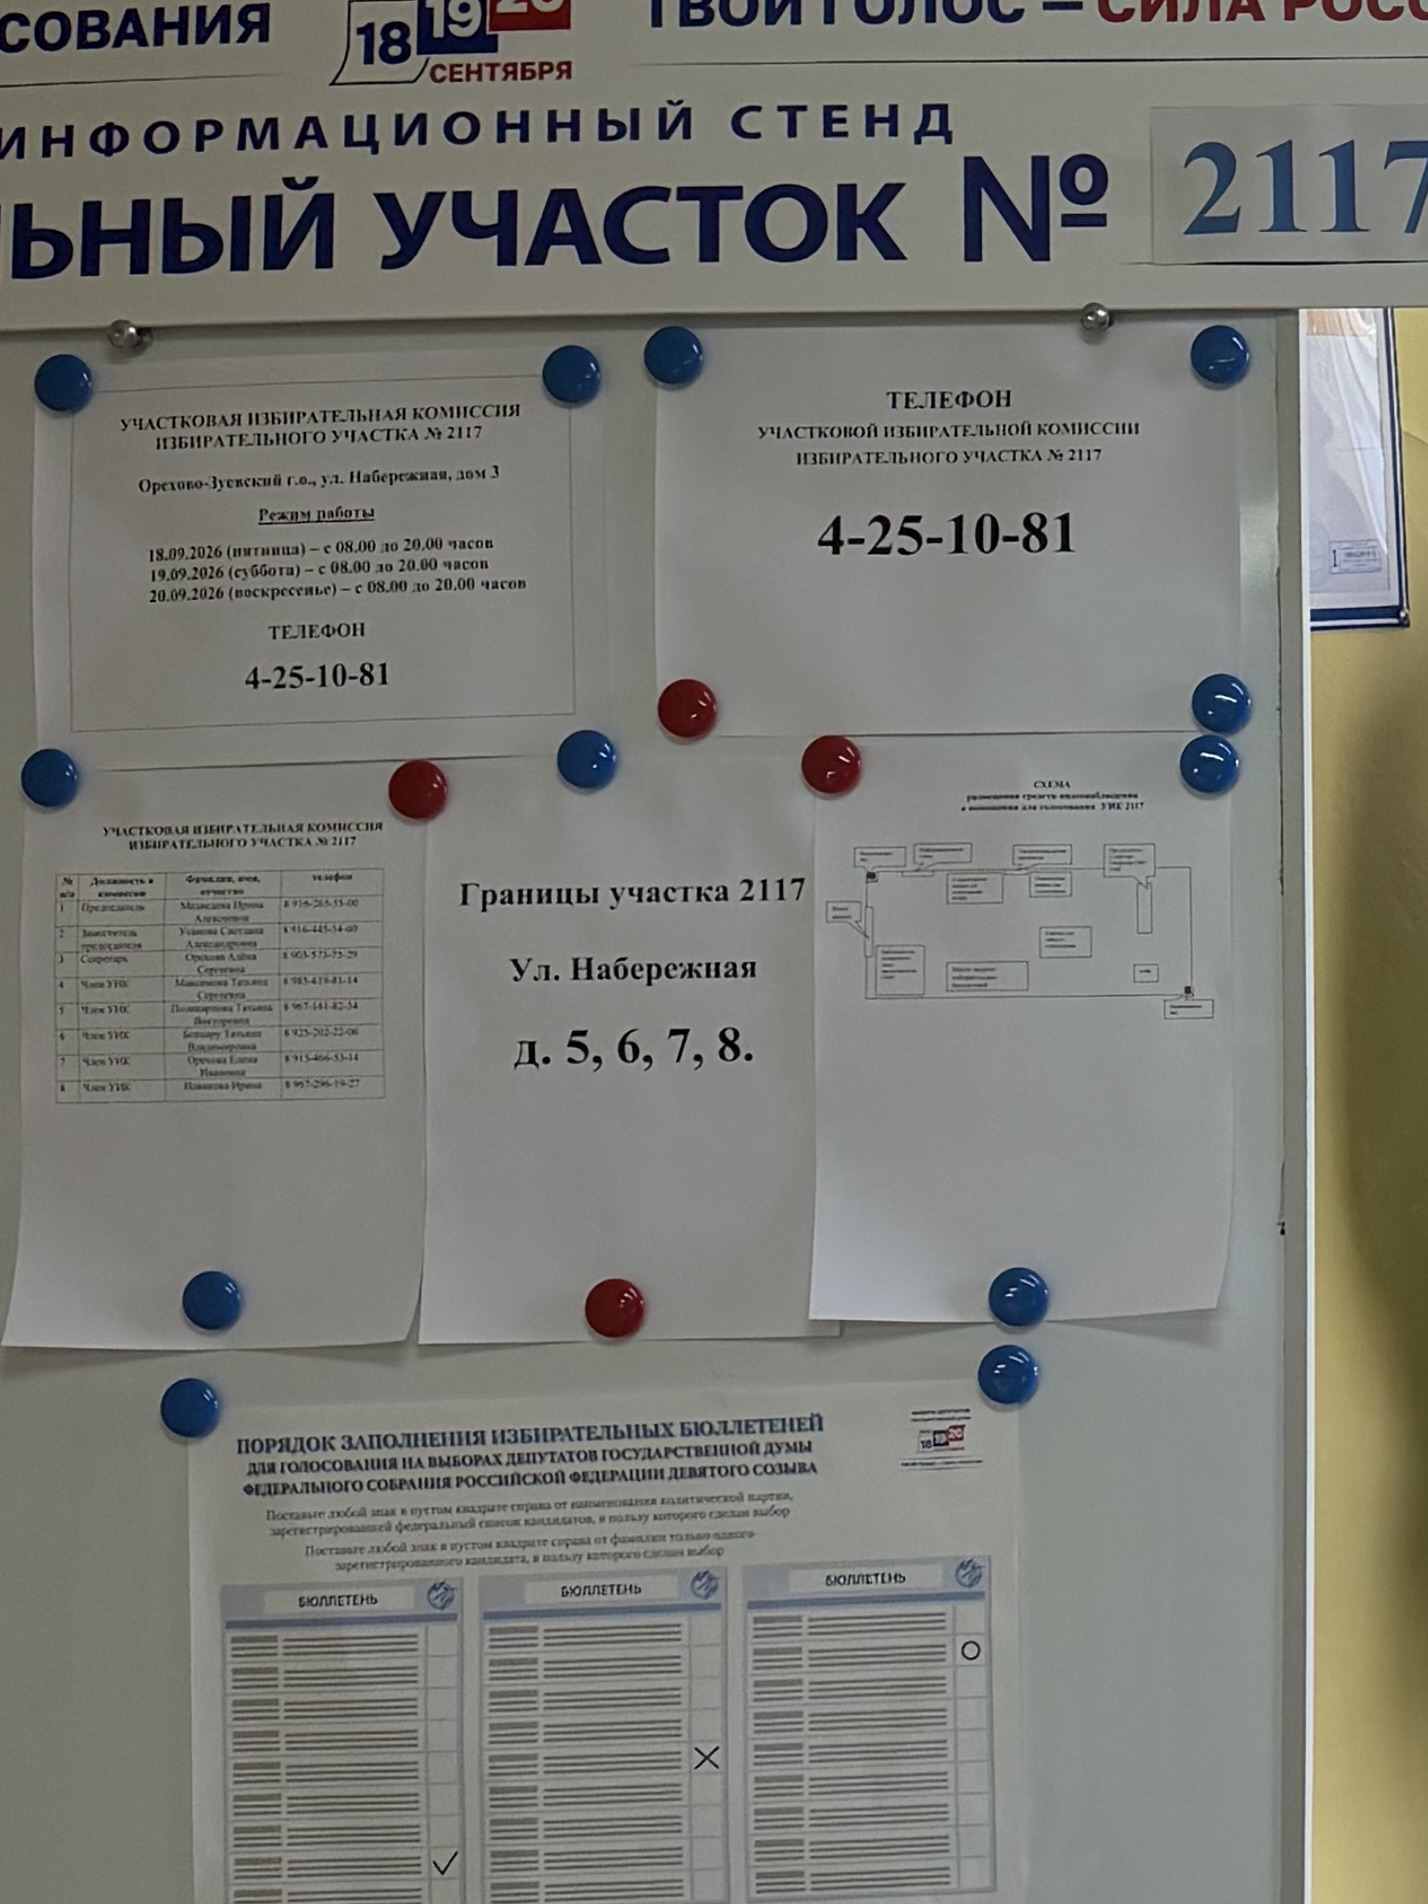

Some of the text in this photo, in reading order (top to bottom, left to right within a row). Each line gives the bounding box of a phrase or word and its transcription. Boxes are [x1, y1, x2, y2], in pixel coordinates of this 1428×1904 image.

[356, 21, 412, 65] 18
[429, 60, 573, 84] СЕНТЯБРЯ
[0, 100, 954, 161] ИНФОРМАЦИОННЫЙ СТЕНД
[375, 181, 908, 271] УЧАСТОК
[963, 154, 1109, 263] №
[886, 390, 1011, 410] ТЕЛЕФОН
[120, 404, 521, 432] УЧАСТКОВАЯ ИЗБИРАТЕЛЬНАЯ КОМИССИЯ
[758, 421, 1140, 439] УЧАСТКОВОЙ ИЗБИРАТЕЛЬНОЙ КОМИССИИ
[156, 431, 326, 450] ИЗБИРАТЕЛЬНОГО
[331, 428, 419, 443] УЧАСТКА
[447, 425, 482, 440] 2117
[796, 451, 958, 465] ИЗБИРАТЕЛЬНОГО
[963, 449, 1043, 464] УЧАСТКА
[1068, 448, 1102, 462] 2117
[320, 474, 344, 489] ул.
[349, 469, 452, 486] Набережная,
[456, 469, 486, 481] дом
[258, 504, 375, 523] Режим работы
[817, 512, 1075, 555] 4-25-10-81
[149, 545, 223, 562] 18.09.2026
[335, 539, 376, 554] 08.00
[403, 537, 443, 552] 20.00
[448, 539, 494, 550] часов
[151, 565, 225, 582] 19.09.2026
[228, 563, 301, 581] (суббота)
[330, 560, 371, 575] 08.00
[398, 557, 438, 573] 20.00
[442, 560, 489, 571] часов
[149, 586, 224, 603] 20.09.2026
[367, 580, 408, 594] 08.00
[435, 577, 475, 592] 20.00
[480, 579, 527, 590] часов
[268, 622, 365, 640] ТЕЛЕФОН
[245, 662, 388, 689] 4-25-10-81
[460, 877, 806, 912] Границы участка 2117
[509, 957, 757, 986] Ул. Набережная
[513, 1027, 753, 1072] д. 5, 6, 7, 8.
[236, 1413, 824, 1455] ПОРЯДОК ЗАПОЛНЕНИЯ ИЗБИРАТЕЛЬНЫХ БЮЛЛЕТЕНЕЙ
[279, 1457, 398, 1474] ГОЛОСОВАНИЯ
[427, 1453, 503, 1469] ВЫБОРАХ
[505, 1449, 599, 1467] ДЕПУТАТОВ
[601, 1441, 761, 1461] ГОСУДАРСТВЕННОЙ
[763, 1440, 813, 1457] ДУМЫ
[366, 1476, 452, 1492] СОБРАНИЯ
[455, 1470, 566, 1488] РОССИЙСКОЙ
[568, 1468, 665, 1484] ФЕДЕРАЦИИ
[560, 1583, 642, 1598] БЮЛЛЕТЕНЬ
[825, 1572, 907, 1587] БЮЛЛЕТЕНЬ
[298, 1594, 379, 1608] БЮЛЛЕТЕНЬ
